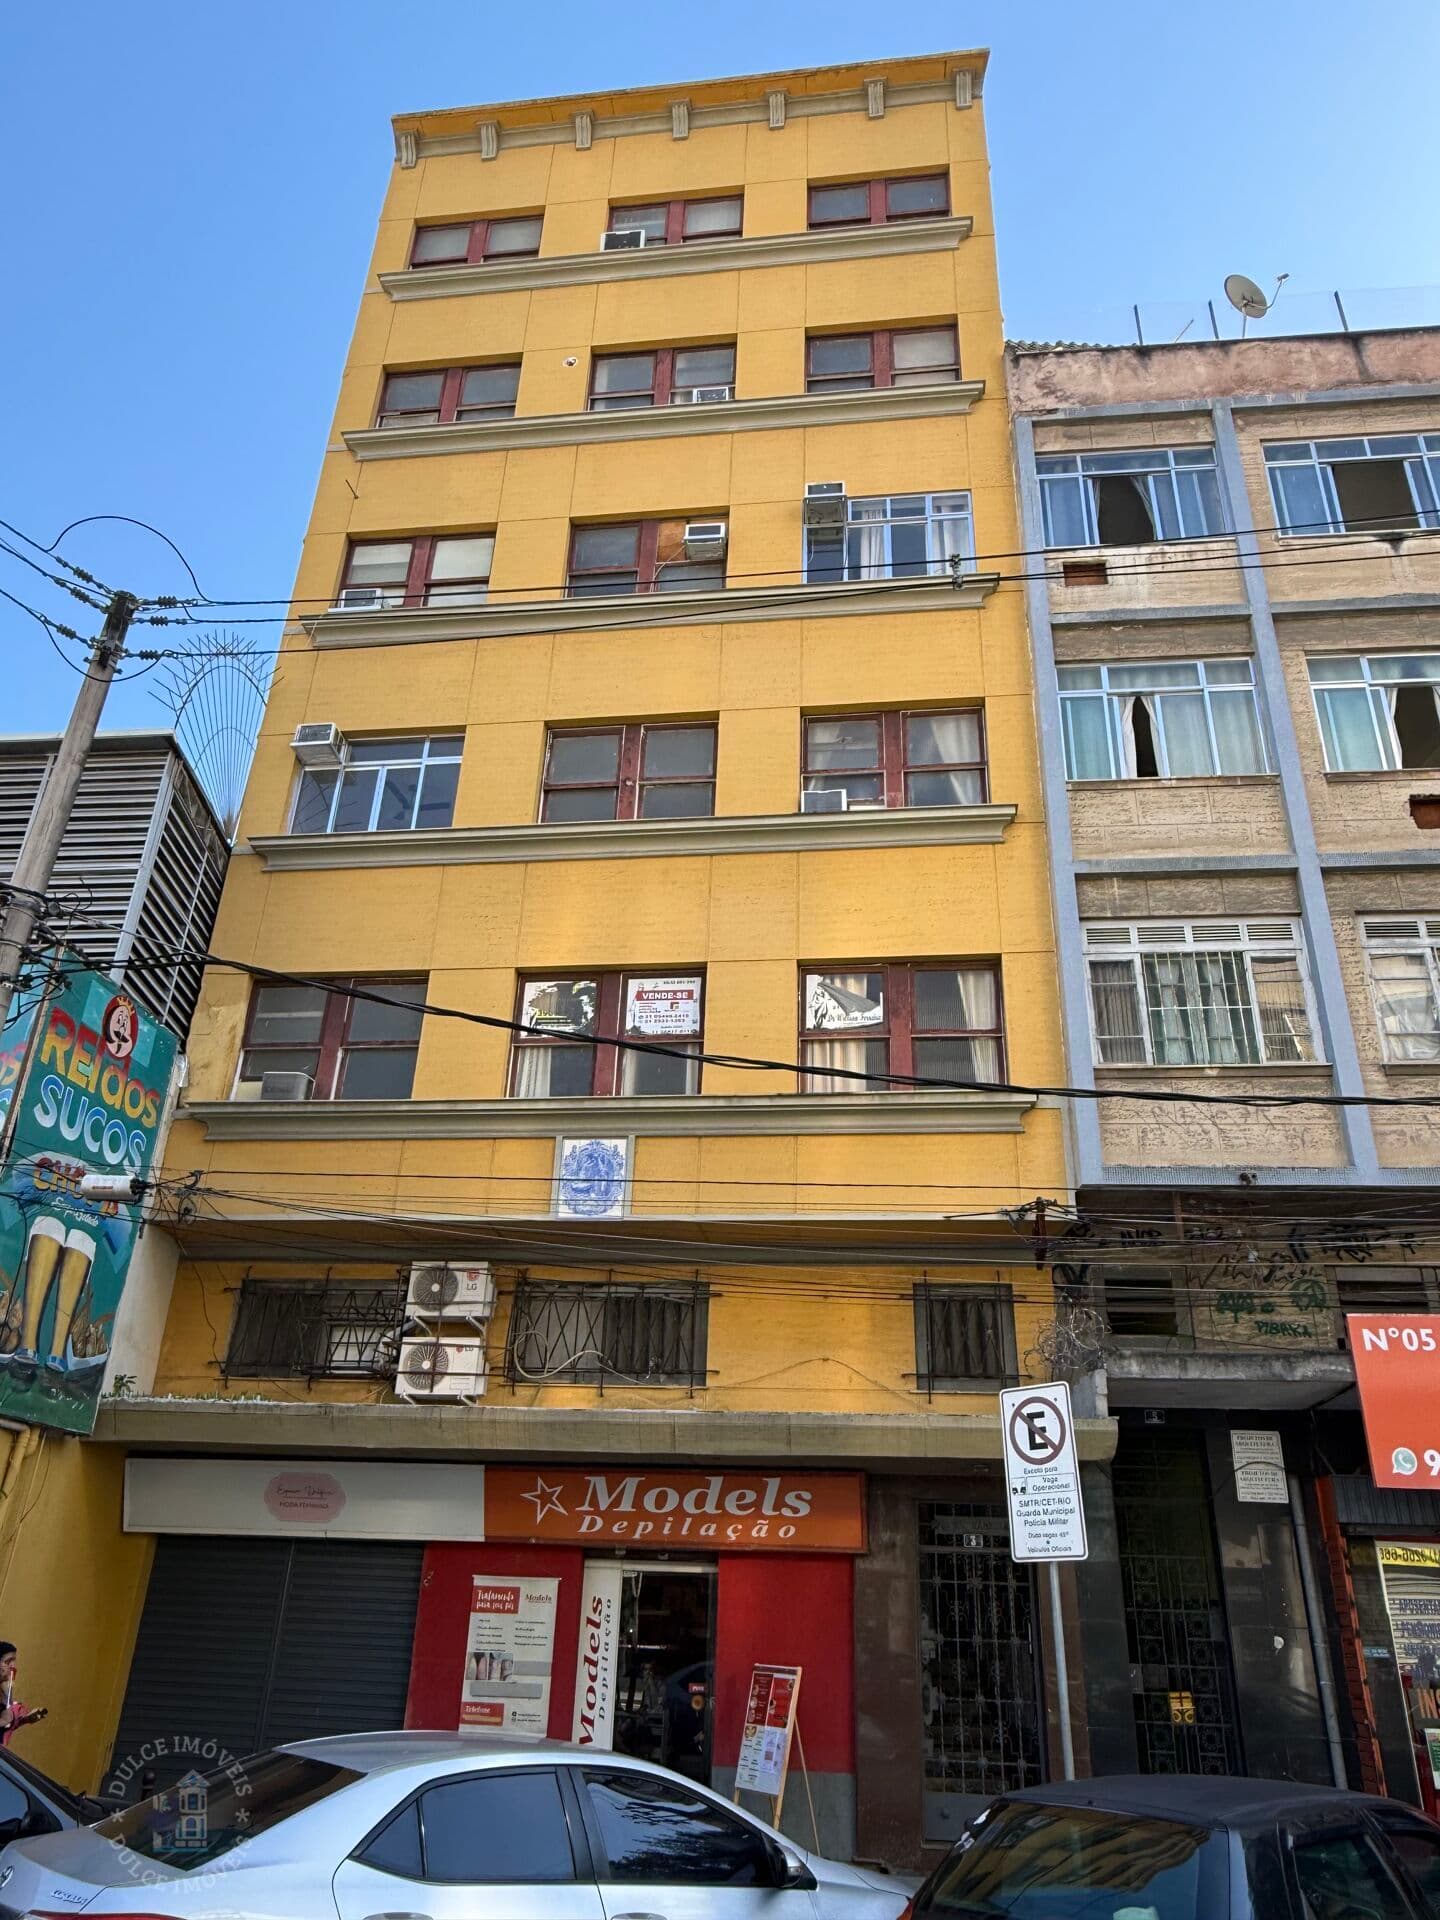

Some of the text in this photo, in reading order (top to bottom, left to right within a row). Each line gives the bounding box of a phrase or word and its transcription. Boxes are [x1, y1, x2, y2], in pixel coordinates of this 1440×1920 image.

[642, 992, 689, 1000] VENDE-SE
[34, 1074, 147, 1177] SUCOS
[466, 1282, 478, 1291] LG
[575, 1476, 813, 1517] Models
[1032, 1482, 1071, 1493] Operacional
[1016, 1507, 1076, 1518] Guarda Municipal
[1048, 1516, 1069, 1526] Militar
[577, 1514, 797, 1541] Depilação
[599, 1598, 612, 1720] Depilação
[579, 1595, 603, 1744] Models
